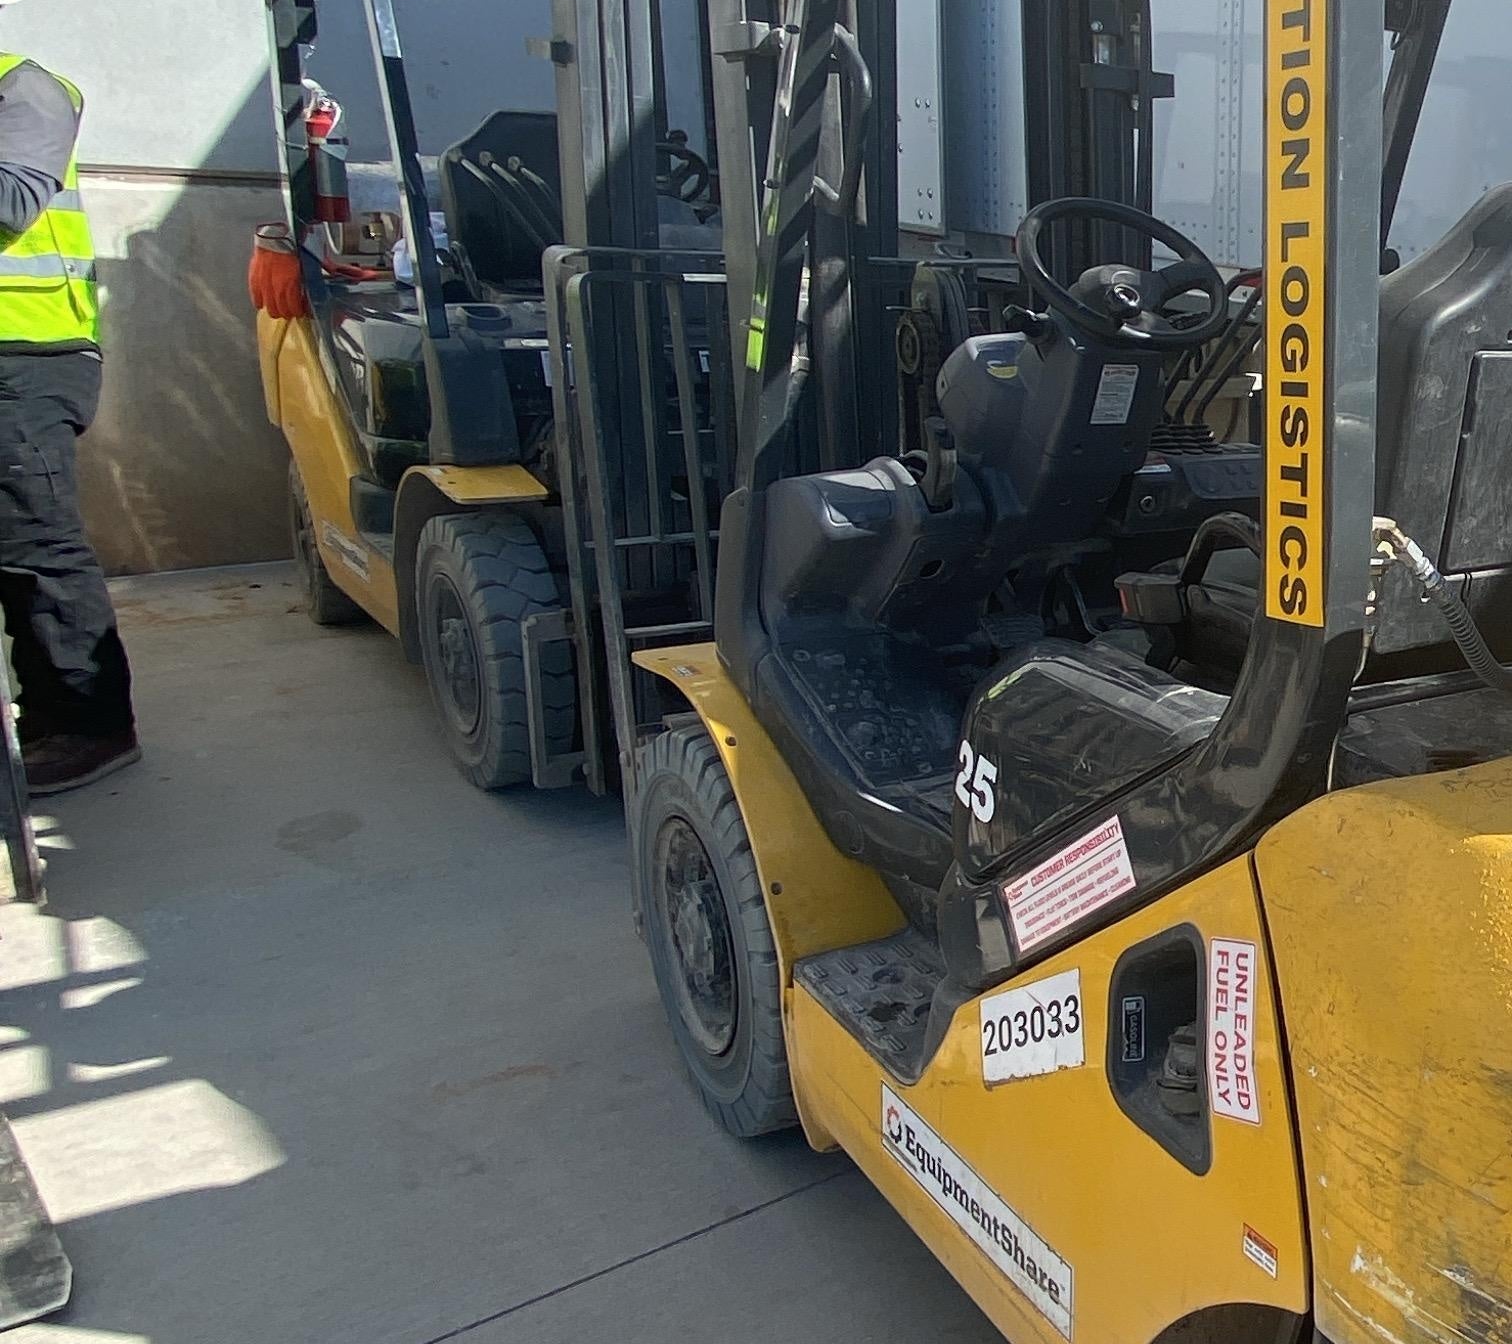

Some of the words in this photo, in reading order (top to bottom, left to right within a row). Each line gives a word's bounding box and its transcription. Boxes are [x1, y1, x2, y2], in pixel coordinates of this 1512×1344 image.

[1278, 221, 1310, 617] LOGISTICS
[955, 739, 998, 823] 25
[1031, 857, 1065, 887] CUSTOMER
[1065, 823, 1119, 866] RESPONSIBILITY
[983, 994, 1080, 1056] 203033
[1215, 950, 1229, 1021] FUEL
[1214, 1030, 1232, 1106] ONLY
[1233, 952, 1251, 1110] UNLEADED
[905, 1124, 1061, 1305] EquipmentShare
